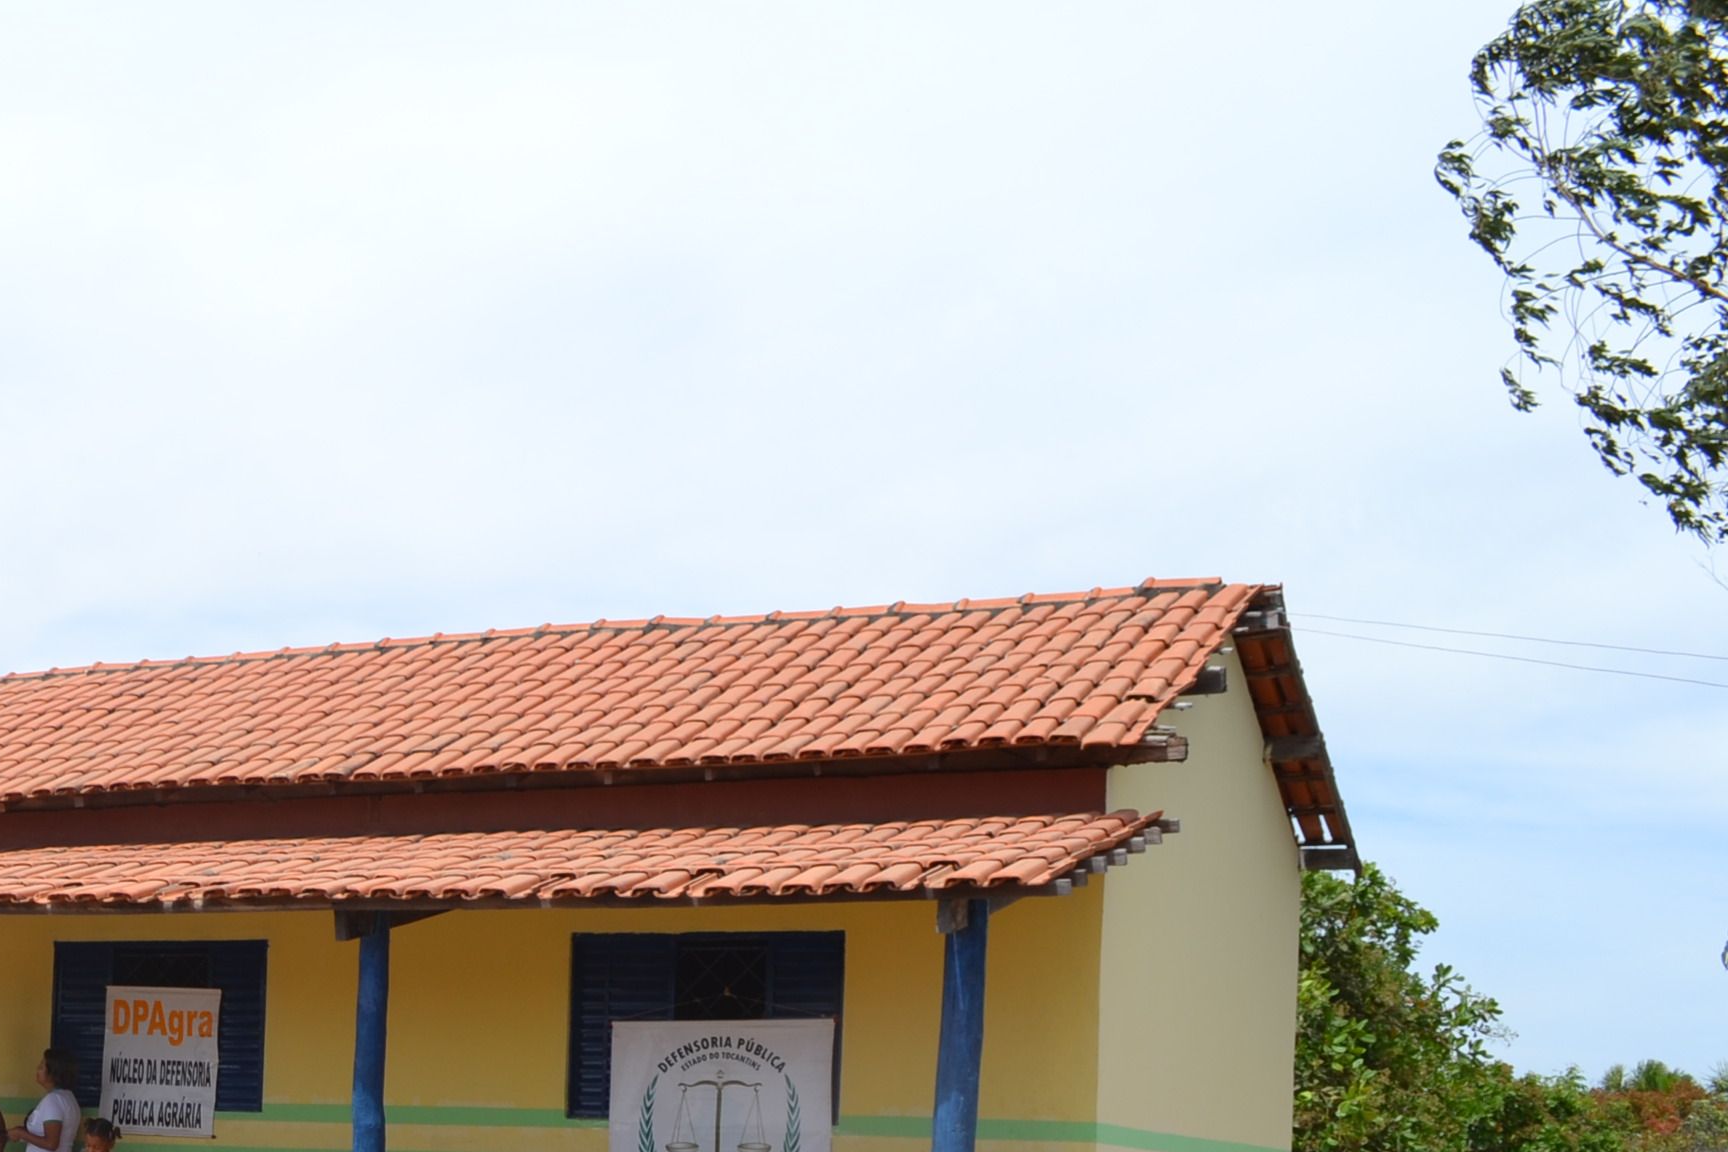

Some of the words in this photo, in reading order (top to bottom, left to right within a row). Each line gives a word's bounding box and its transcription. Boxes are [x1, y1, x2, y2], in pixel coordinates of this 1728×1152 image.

[112, 998, 214, 1047] DPAgra
[110, 1051, 144, 1084] NÚCLEO
[146, 1060, 158, 1085] DA
[159, 1059, 212, 1087] DEFENSORIA
[657, 1036, 732, 1073] DEFENSORIA
[737, 1037, 786, 1073] PÚBLICA
[680, 1054, 707, 1071] ESTADO
[709, 1052, 719, 1060] DO
[722, 1051, 761, 1071] TOCANTINS
[111, 1093, 154, 1126] PÚBLICA
[157, 1096, 202, 1129] AGRÁRIA
